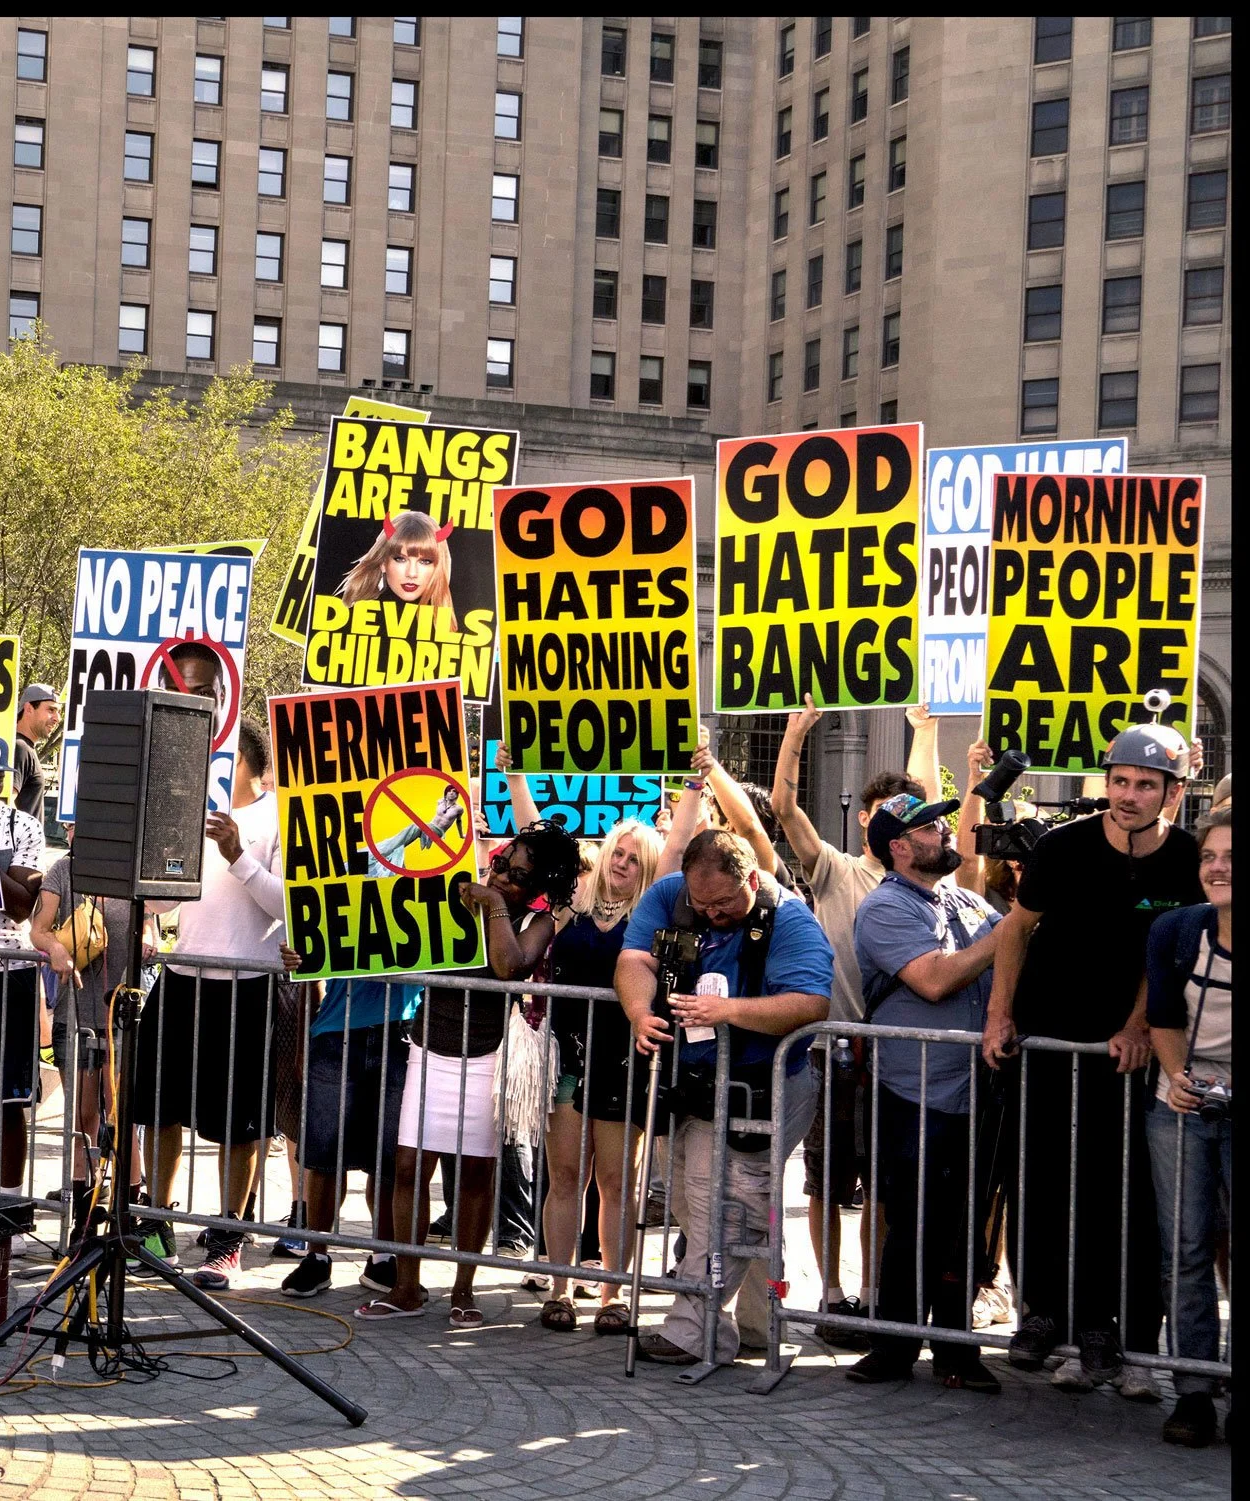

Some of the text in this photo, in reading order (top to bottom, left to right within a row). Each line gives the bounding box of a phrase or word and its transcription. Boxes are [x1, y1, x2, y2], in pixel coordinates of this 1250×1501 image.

[333, 422, 511, 483] BANGS
[725, 432, 912, 524] GOD
[325, 470, 414, 521] ARE
[499, 486, 688, 560] GOD
[993, 476, 1199, 547] MORNING
[75, 557, 131, 636] NO
[138, 560, 246, 643] PEACE
[503, 566, 689, 622] HATES
[719, 522, 917, 617] HATES
[928, 545, 988, 617] PEO
[992, 549, 1196, 621] PEOPLE
[311, 594, 494, 647] DEVILS
[306, 631, 491, 698] CHILDREN
[507, 629, 689, 692] MORNING
[721, 616, 913, 708] BANGS
[925, 638, 985, 705] FROM
[988, 624, 1189, 696] ARE
[275, 687, 463, 788] MERMEN
[509, 698, 694, 772] PEOPLE
[989, 698, 1188, 769] BEAS
[485, 772, 662, 802] DEVILS
[286, 790, 368, 881] ARE
[289, 871, 479, 974] BEASTS
